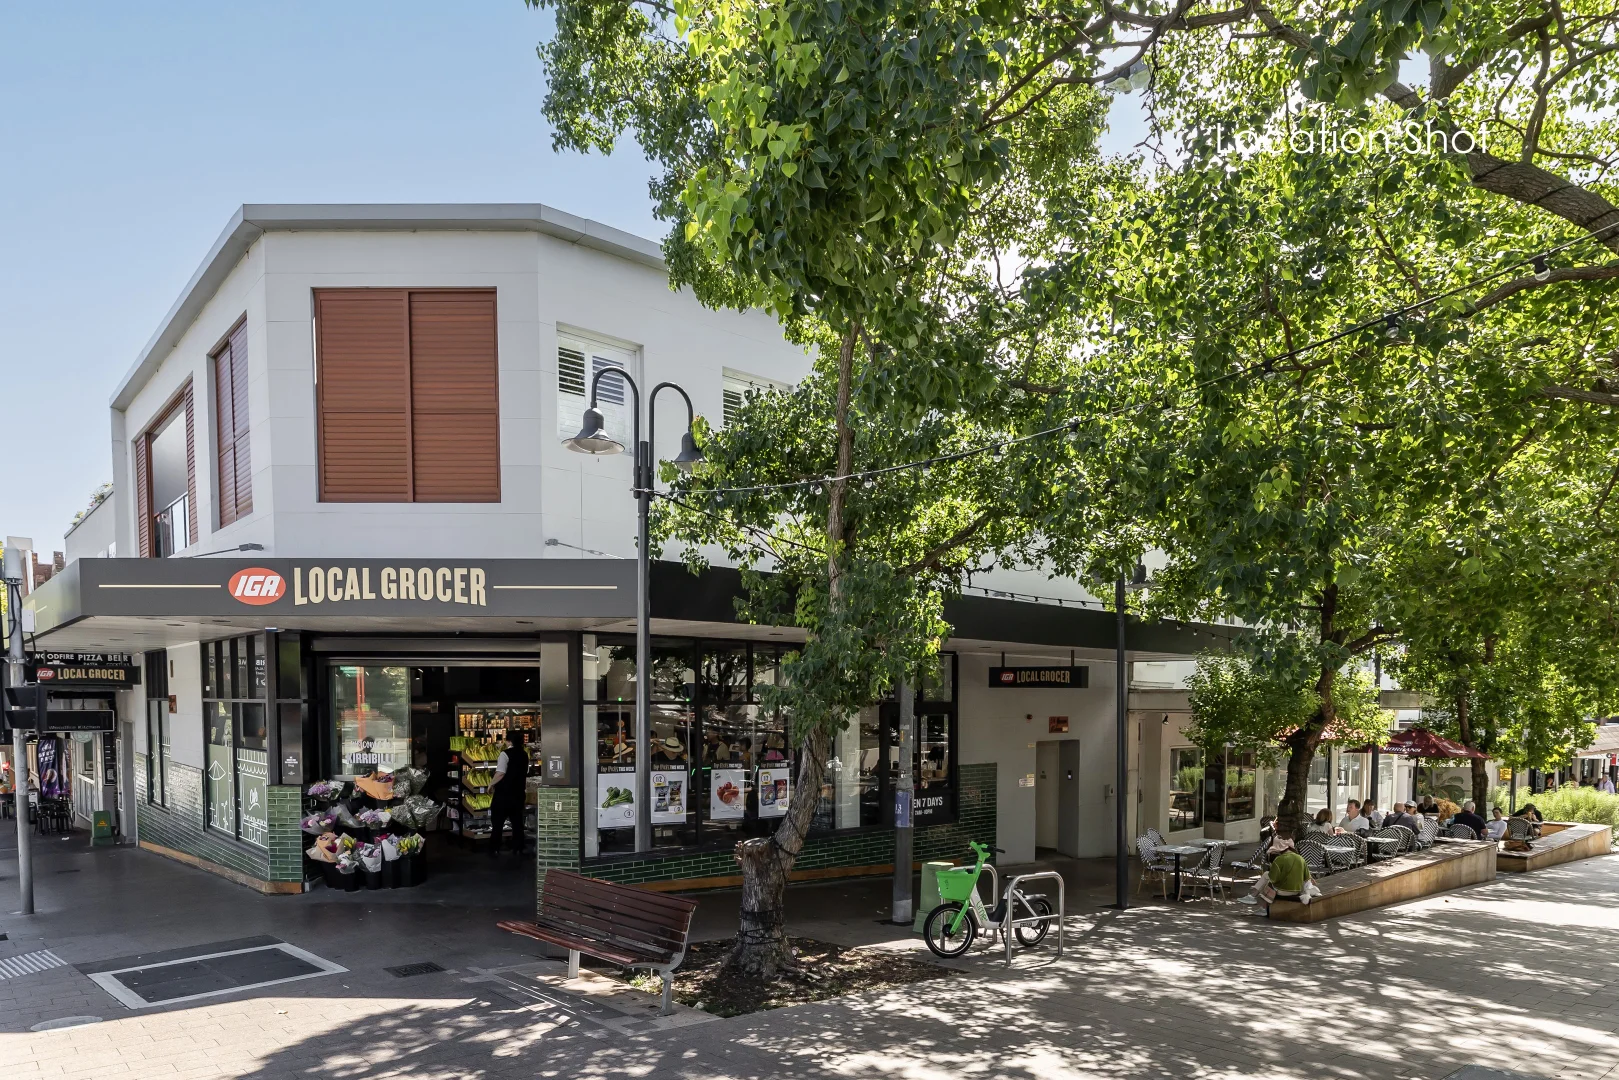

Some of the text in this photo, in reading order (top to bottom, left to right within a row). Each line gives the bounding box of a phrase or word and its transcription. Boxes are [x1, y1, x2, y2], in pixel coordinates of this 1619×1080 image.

[234, 575, 281, 597] IGA
[293, 566, 487, 606] LOCAL GROCER
[78, 654, 103, 662] PIZZA
[57, 668, 125, 681] LOCAL GROCER
[1001, 673, 1014, 681] IGA
[1016, 670, 1071, 683] LOCAL GROCER
[922, 798, 927, 807] 7
[927, 796, 943, 807] DAYS
